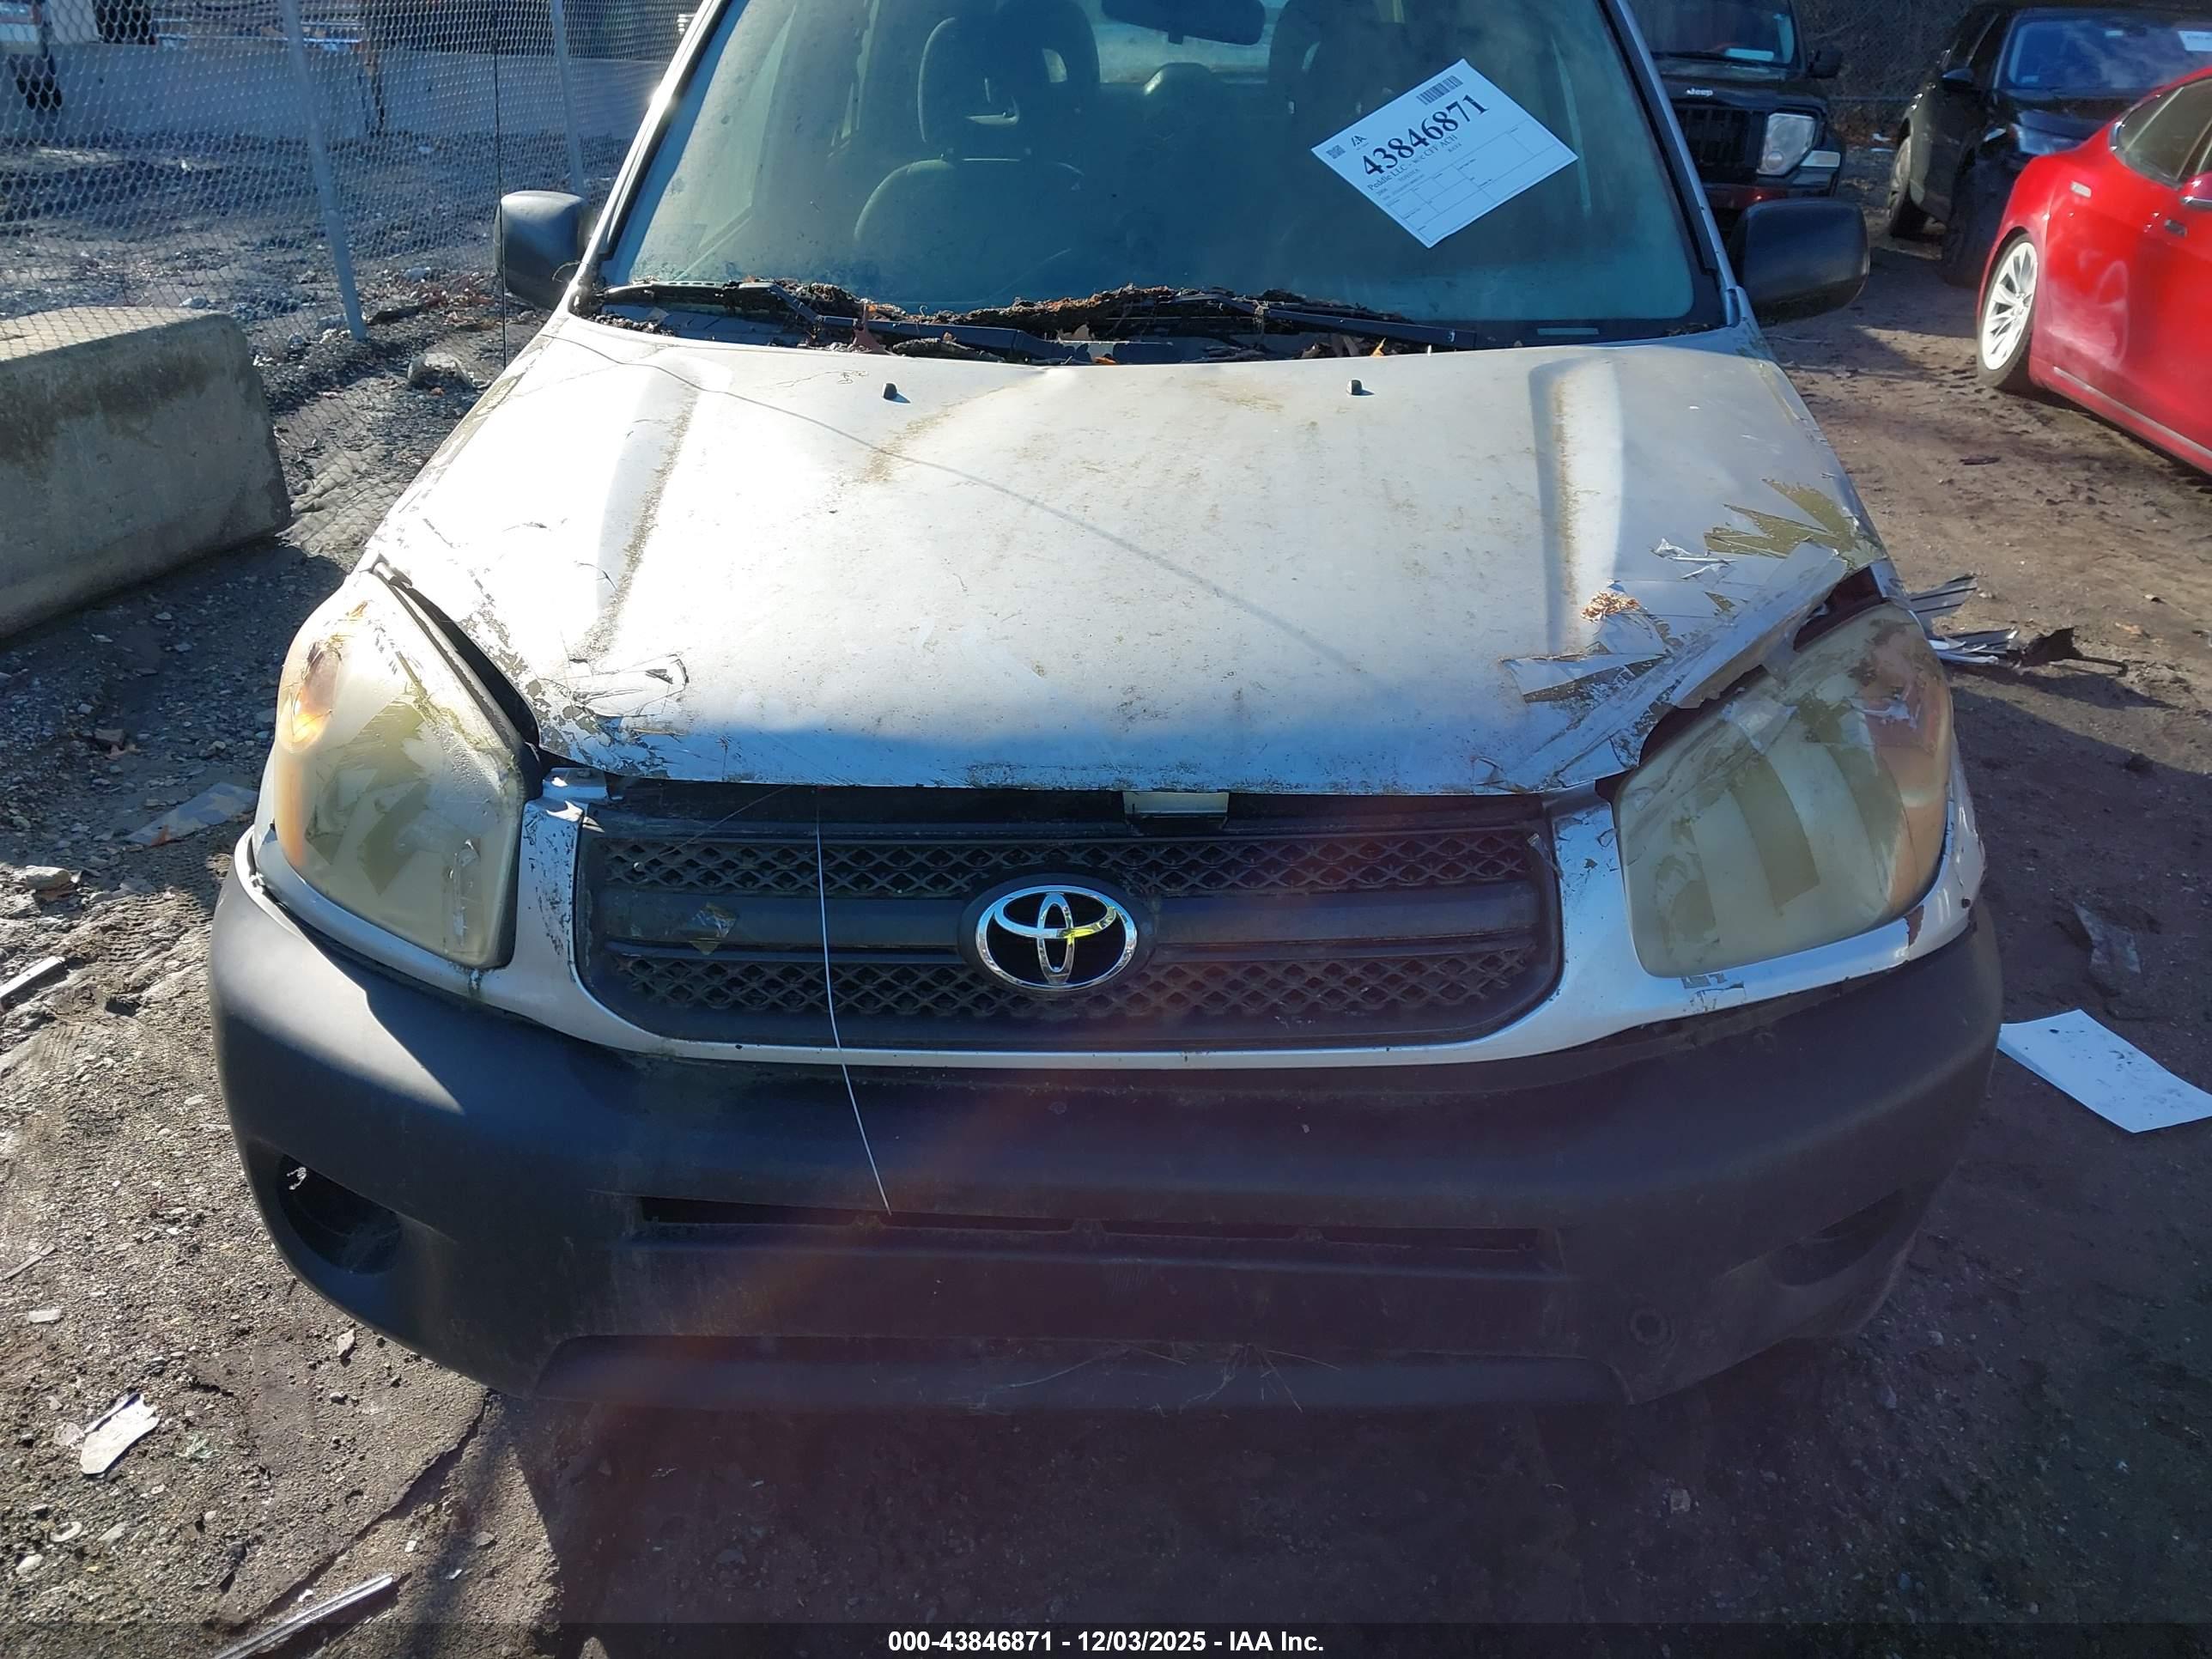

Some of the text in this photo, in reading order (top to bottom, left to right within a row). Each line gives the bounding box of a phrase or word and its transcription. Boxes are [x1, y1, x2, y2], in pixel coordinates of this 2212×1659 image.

[1686, 88, 1713, 97] Jeep
[1362, 94, 1490, 177] 43846871
[1367, 173, 1393, 191] Peddle
[1389, 163, 1408, 177] LLC
